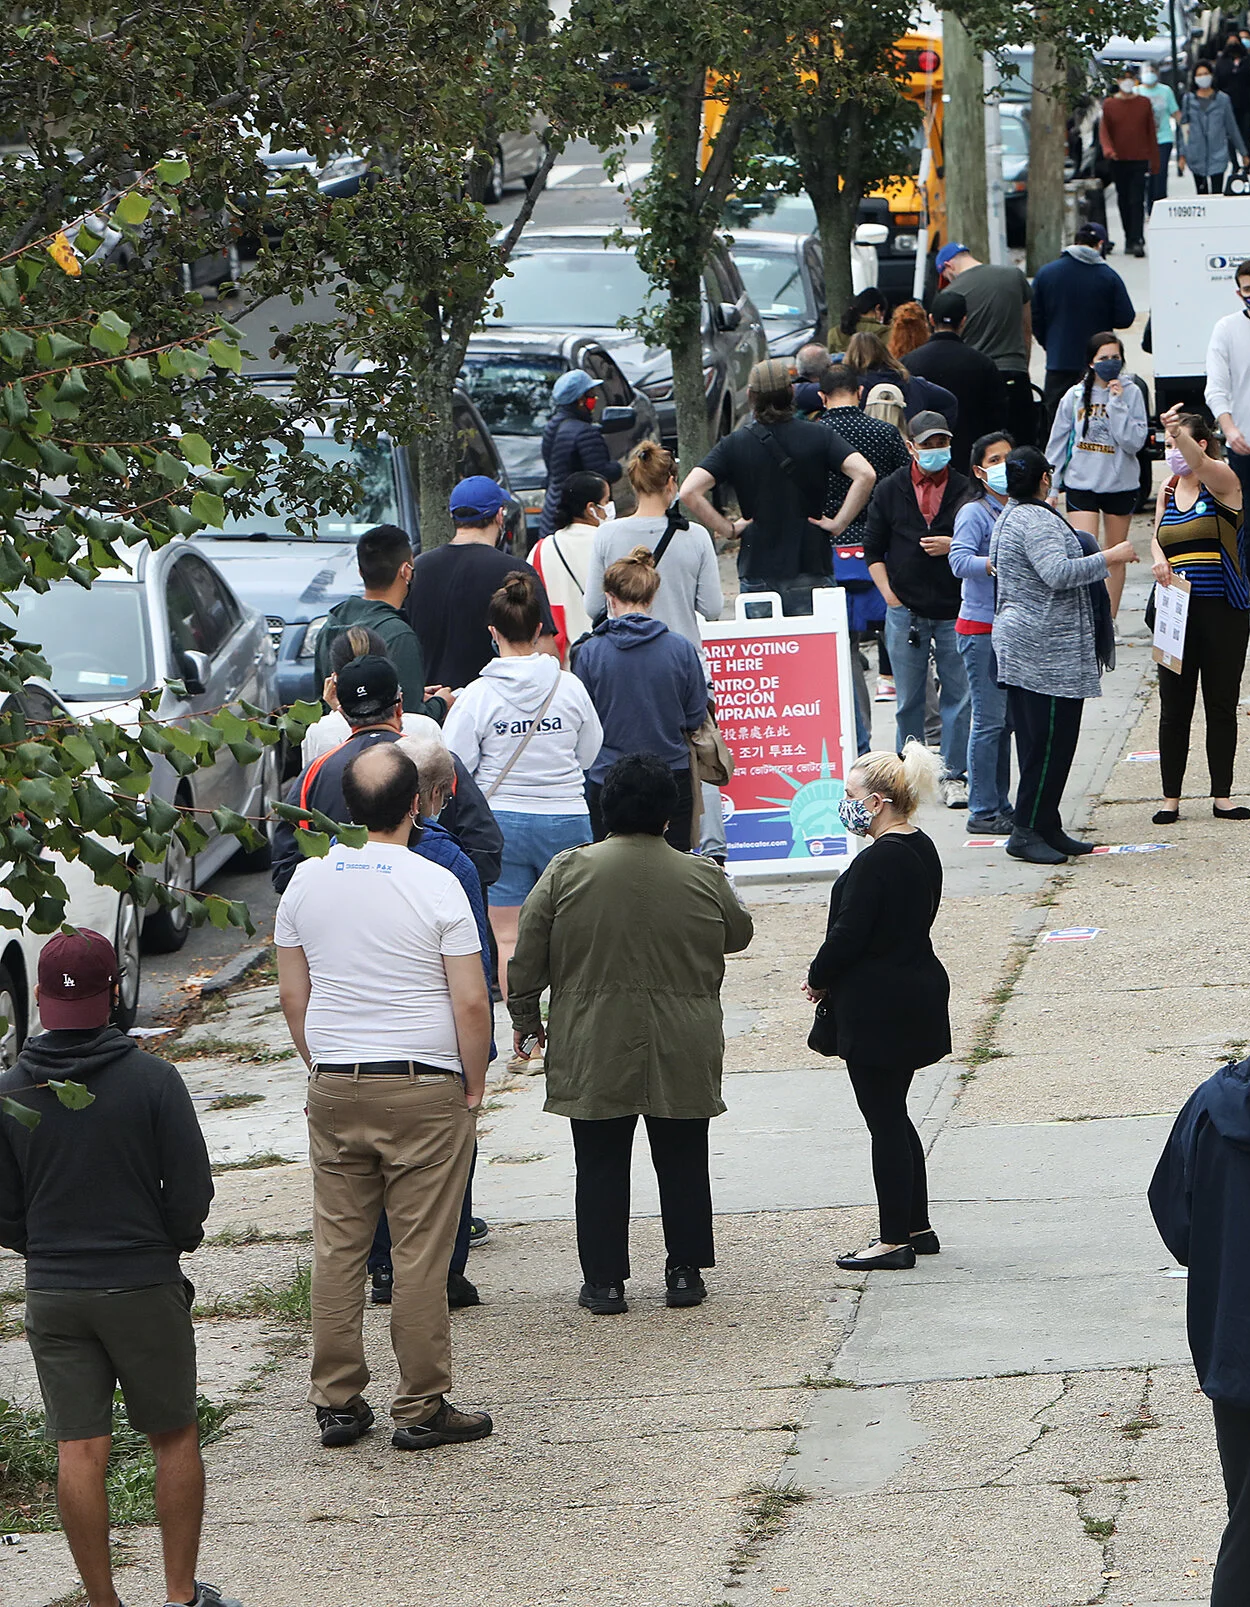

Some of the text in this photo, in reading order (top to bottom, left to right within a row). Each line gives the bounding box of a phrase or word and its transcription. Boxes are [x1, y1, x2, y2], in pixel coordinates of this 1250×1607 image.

[1168, 206, 1206, 217] 11090721
[703, 641, 799, 659] ARLY VOTING
[706, 658, 764, 673] TE HERE
[712, 676, 780, 692] NTRO DE
[715, 689, 775, 706] TACIÓN
[714, 700, 821, 721] MPRANA AQUÍ
[719, 725, 791, 740] 投票處在此
[739, 746, 765, 759] 조기
[768, 744, 807, 757] 투표소
[726, 840, 788, 849] llsitelocator.com
